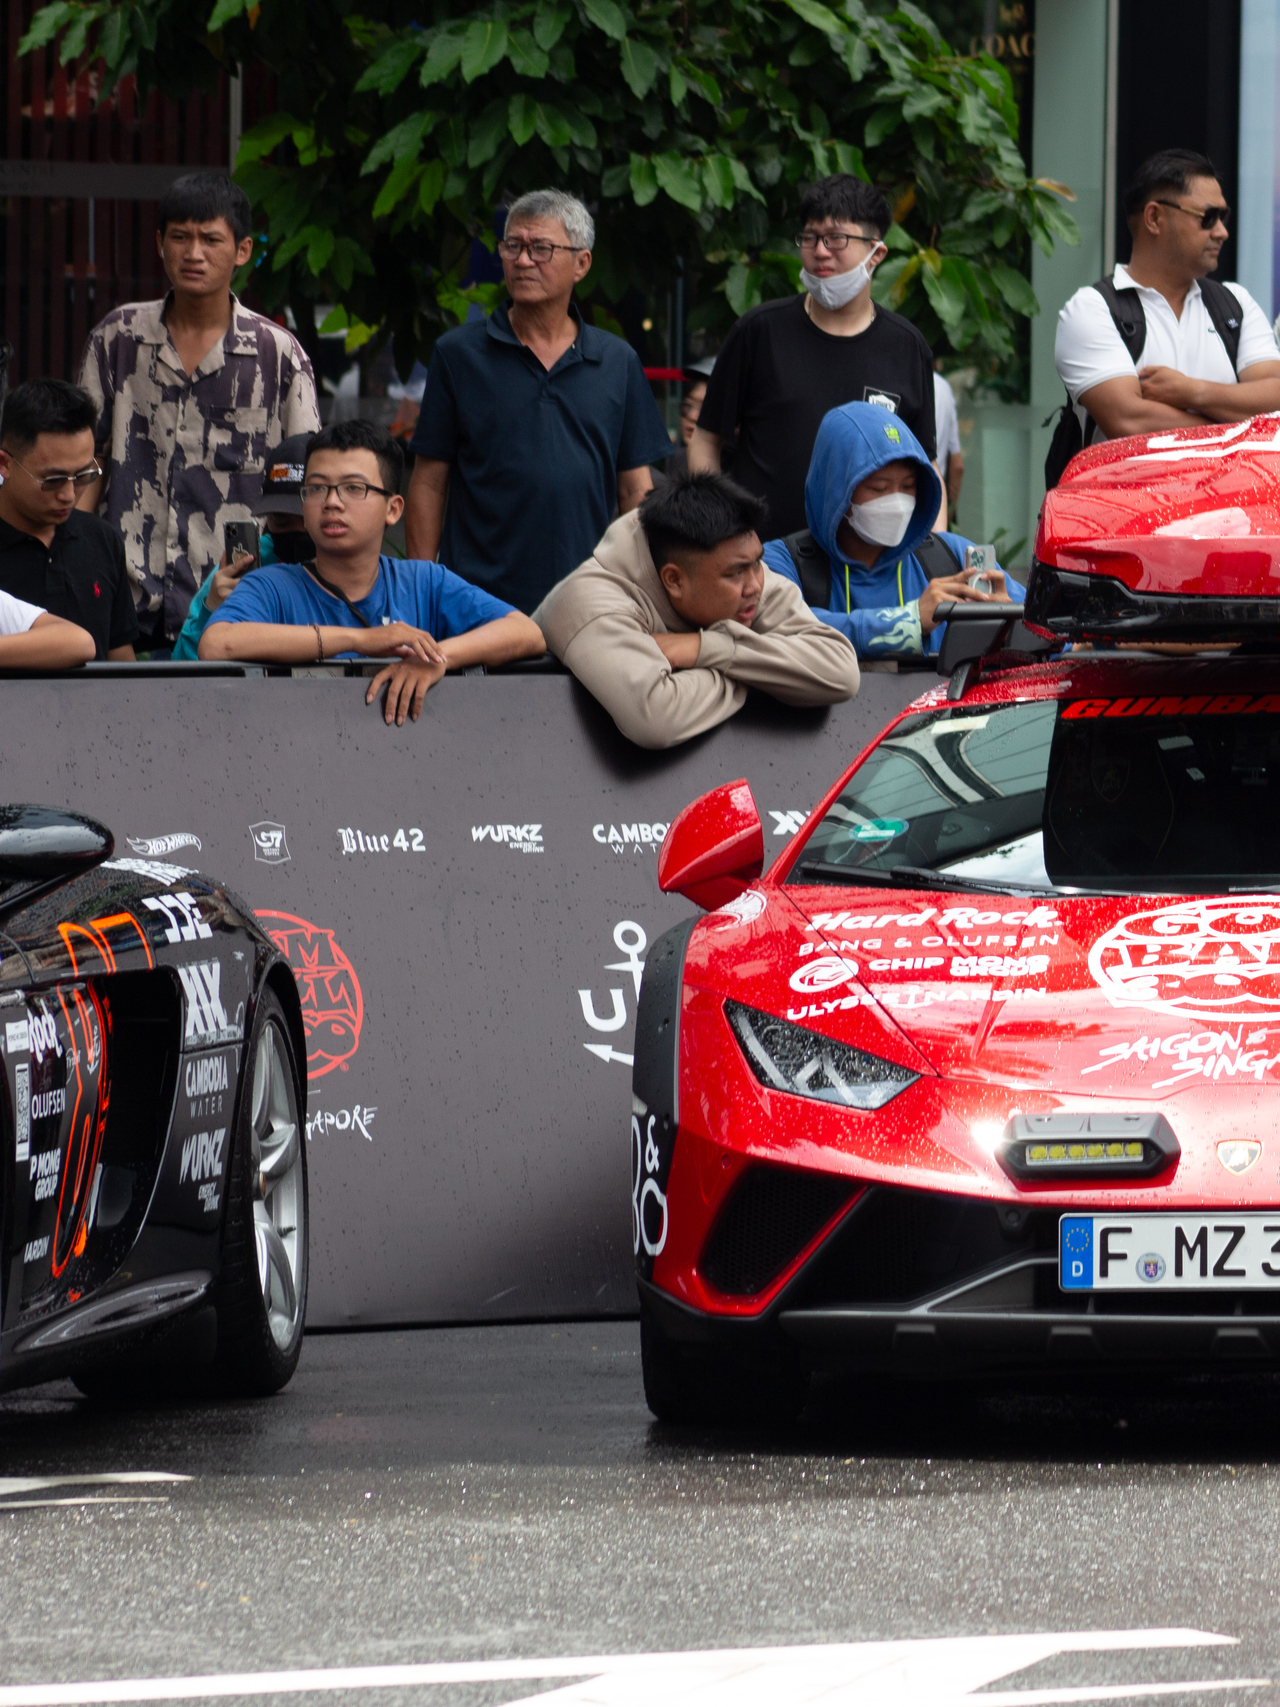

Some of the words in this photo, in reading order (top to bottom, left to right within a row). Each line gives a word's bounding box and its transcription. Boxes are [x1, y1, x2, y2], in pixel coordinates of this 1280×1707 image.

[147, 836, 167, 855] HOT
[256, 829, 283, 849] G7
[337, 827, 390, 855] Blue
[392, 827, 427, 852] 42
[471, 824, 543, 842] WURKZ
[592, 822, 672, 843] CAMBO
[805, 907, 938, 932] Hard
[937, 906, 1059, 928] Rock
[798, 936, 882, 957] BANG
[894, 937, 912, 948] &
[921, 934, 1060, 948] OLUFSEN
[868, 957, 945, 971] CHIP
[951, 955, 1050, 968] MONG
[950, 965, 1048, 977] GROUP
[787, 992, 900, 1021] ULYSSE
[924, 987, 1047, 1003] NARDIN
[1080, 1024, 1244, 1074] SAIGON
[185, 1056, 228, 1098] CAMBODIA
[31, 1088, 66, 1120] OLUFSEN
[190, 1098, 223, 1119] WATER
[38, 1148, 61, 1176] MONG
[179, 1127, 226, 1185] WURKZ
[35, 1174, 58, 1201] GROUP
[1099, 1227, 1133, 1278] F
[1174, 1226, 1246, 1277] MZ
[1072, 1261, 1083, 1276] D
